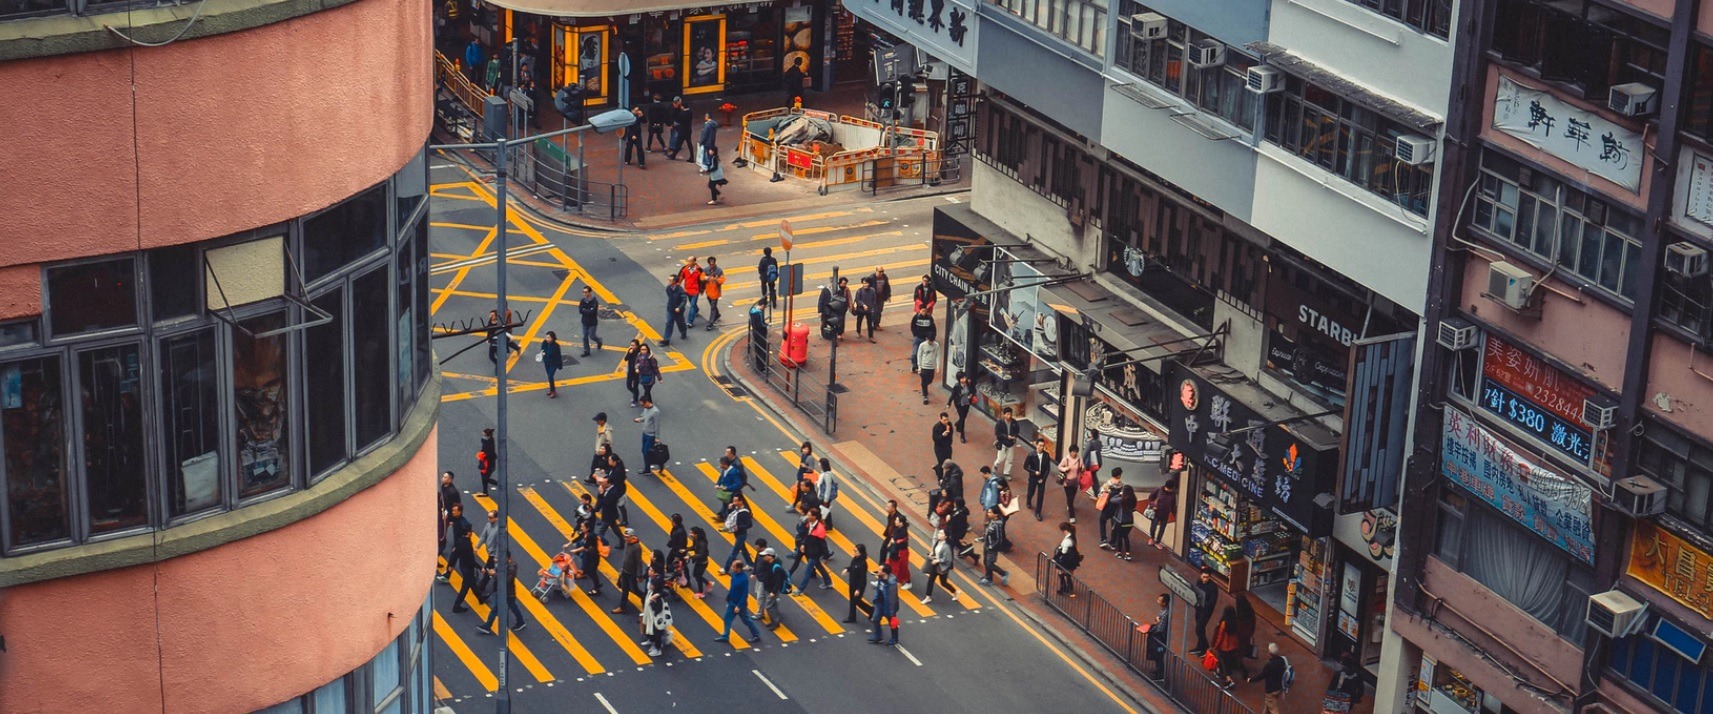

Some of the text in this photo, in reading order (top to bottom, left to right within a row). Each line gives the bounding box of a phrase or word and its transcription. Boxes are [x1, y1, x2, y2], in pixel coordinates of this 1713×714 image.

[934, 263, 969, 293] CITY CHAIN
[1487, 338, 1560, 392] 美姿妍肌
[1508, 398, 1545, 433] $380
